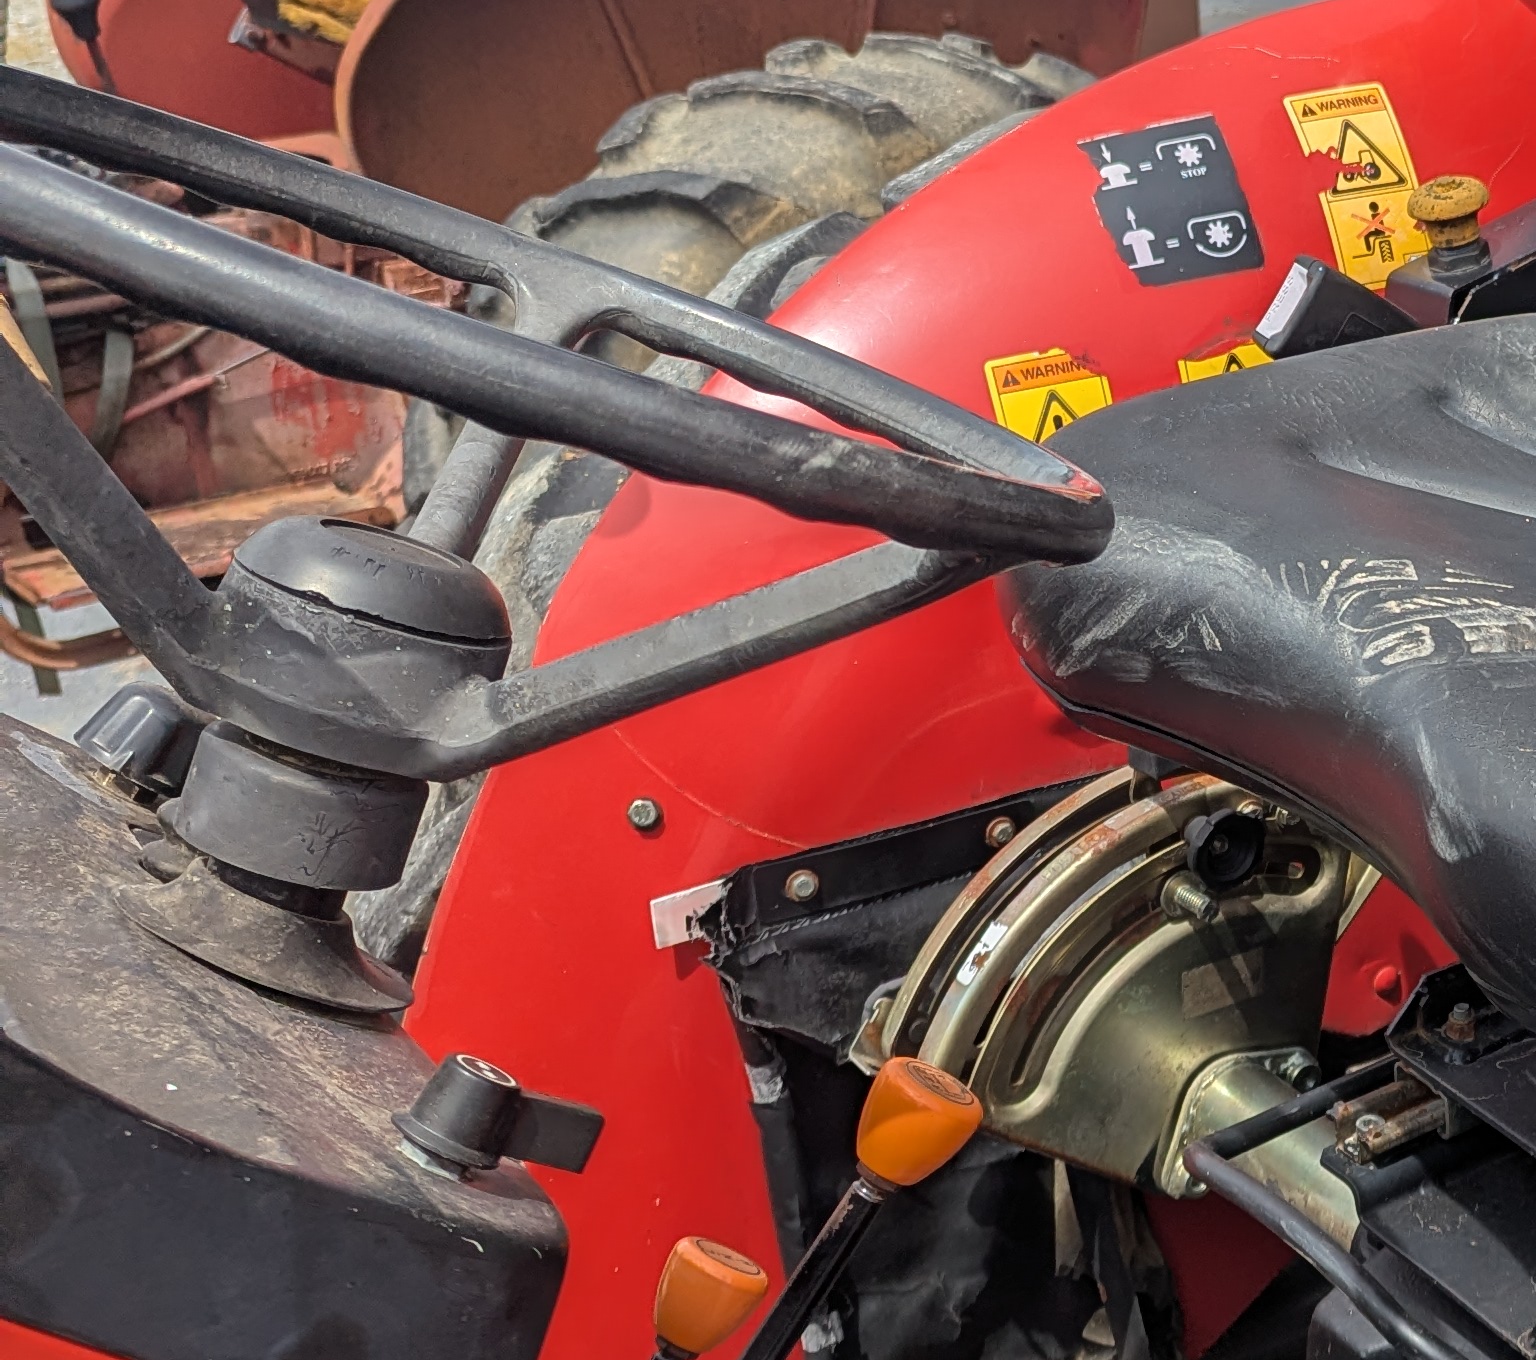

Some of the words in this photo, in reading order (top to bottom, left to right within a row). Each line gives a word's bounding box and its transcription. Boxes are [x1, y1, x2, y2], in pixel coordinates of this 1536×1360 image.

[1316, 95, 1378, 112] WARNING
[1180, 167, 1207, 179] STOP
[1265, 276, 1294, 322] PRESS
[1020, 360, 1087, 381] WARNIN
